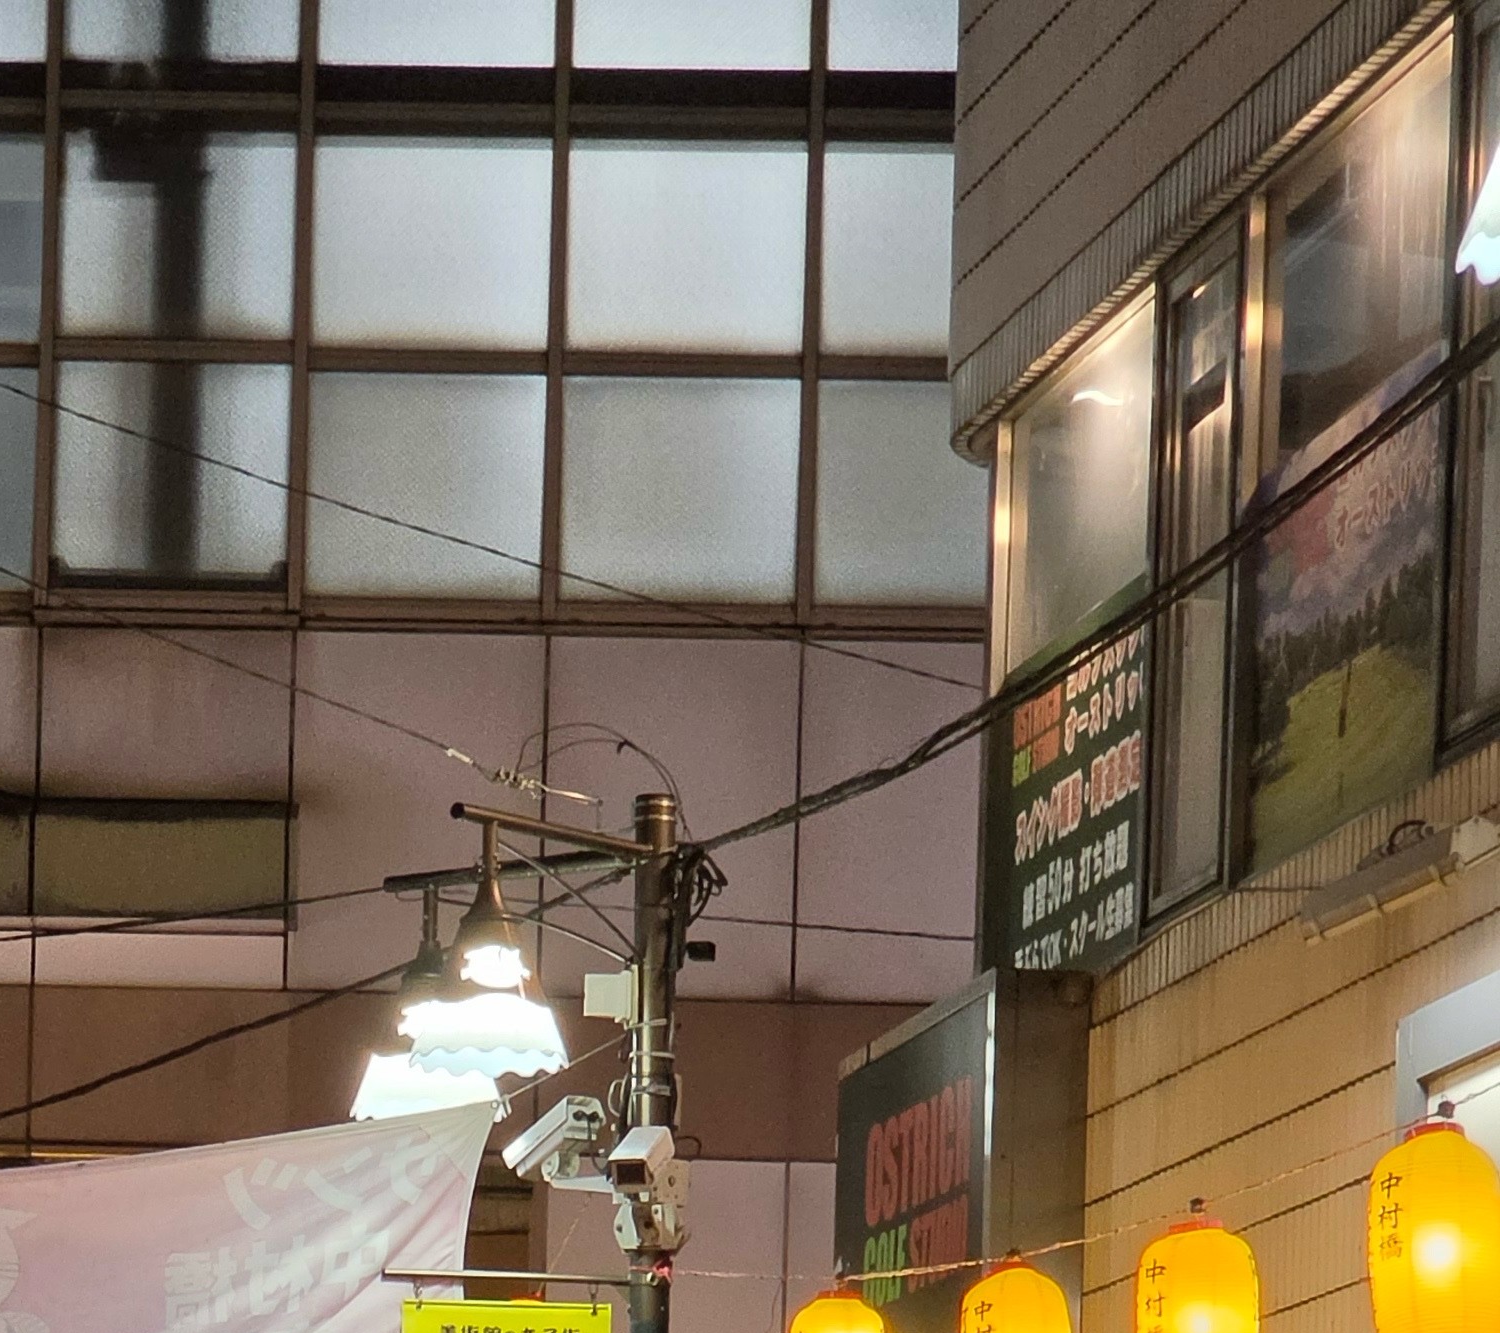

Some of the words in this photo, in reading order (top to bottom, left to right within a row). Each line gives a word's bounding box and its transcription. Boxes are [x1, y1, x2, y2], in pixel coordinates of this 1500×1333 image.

[864, 1074, 973, 1227] OSTRICH
[1377, 1171, 1405, 1260] 中村橋
